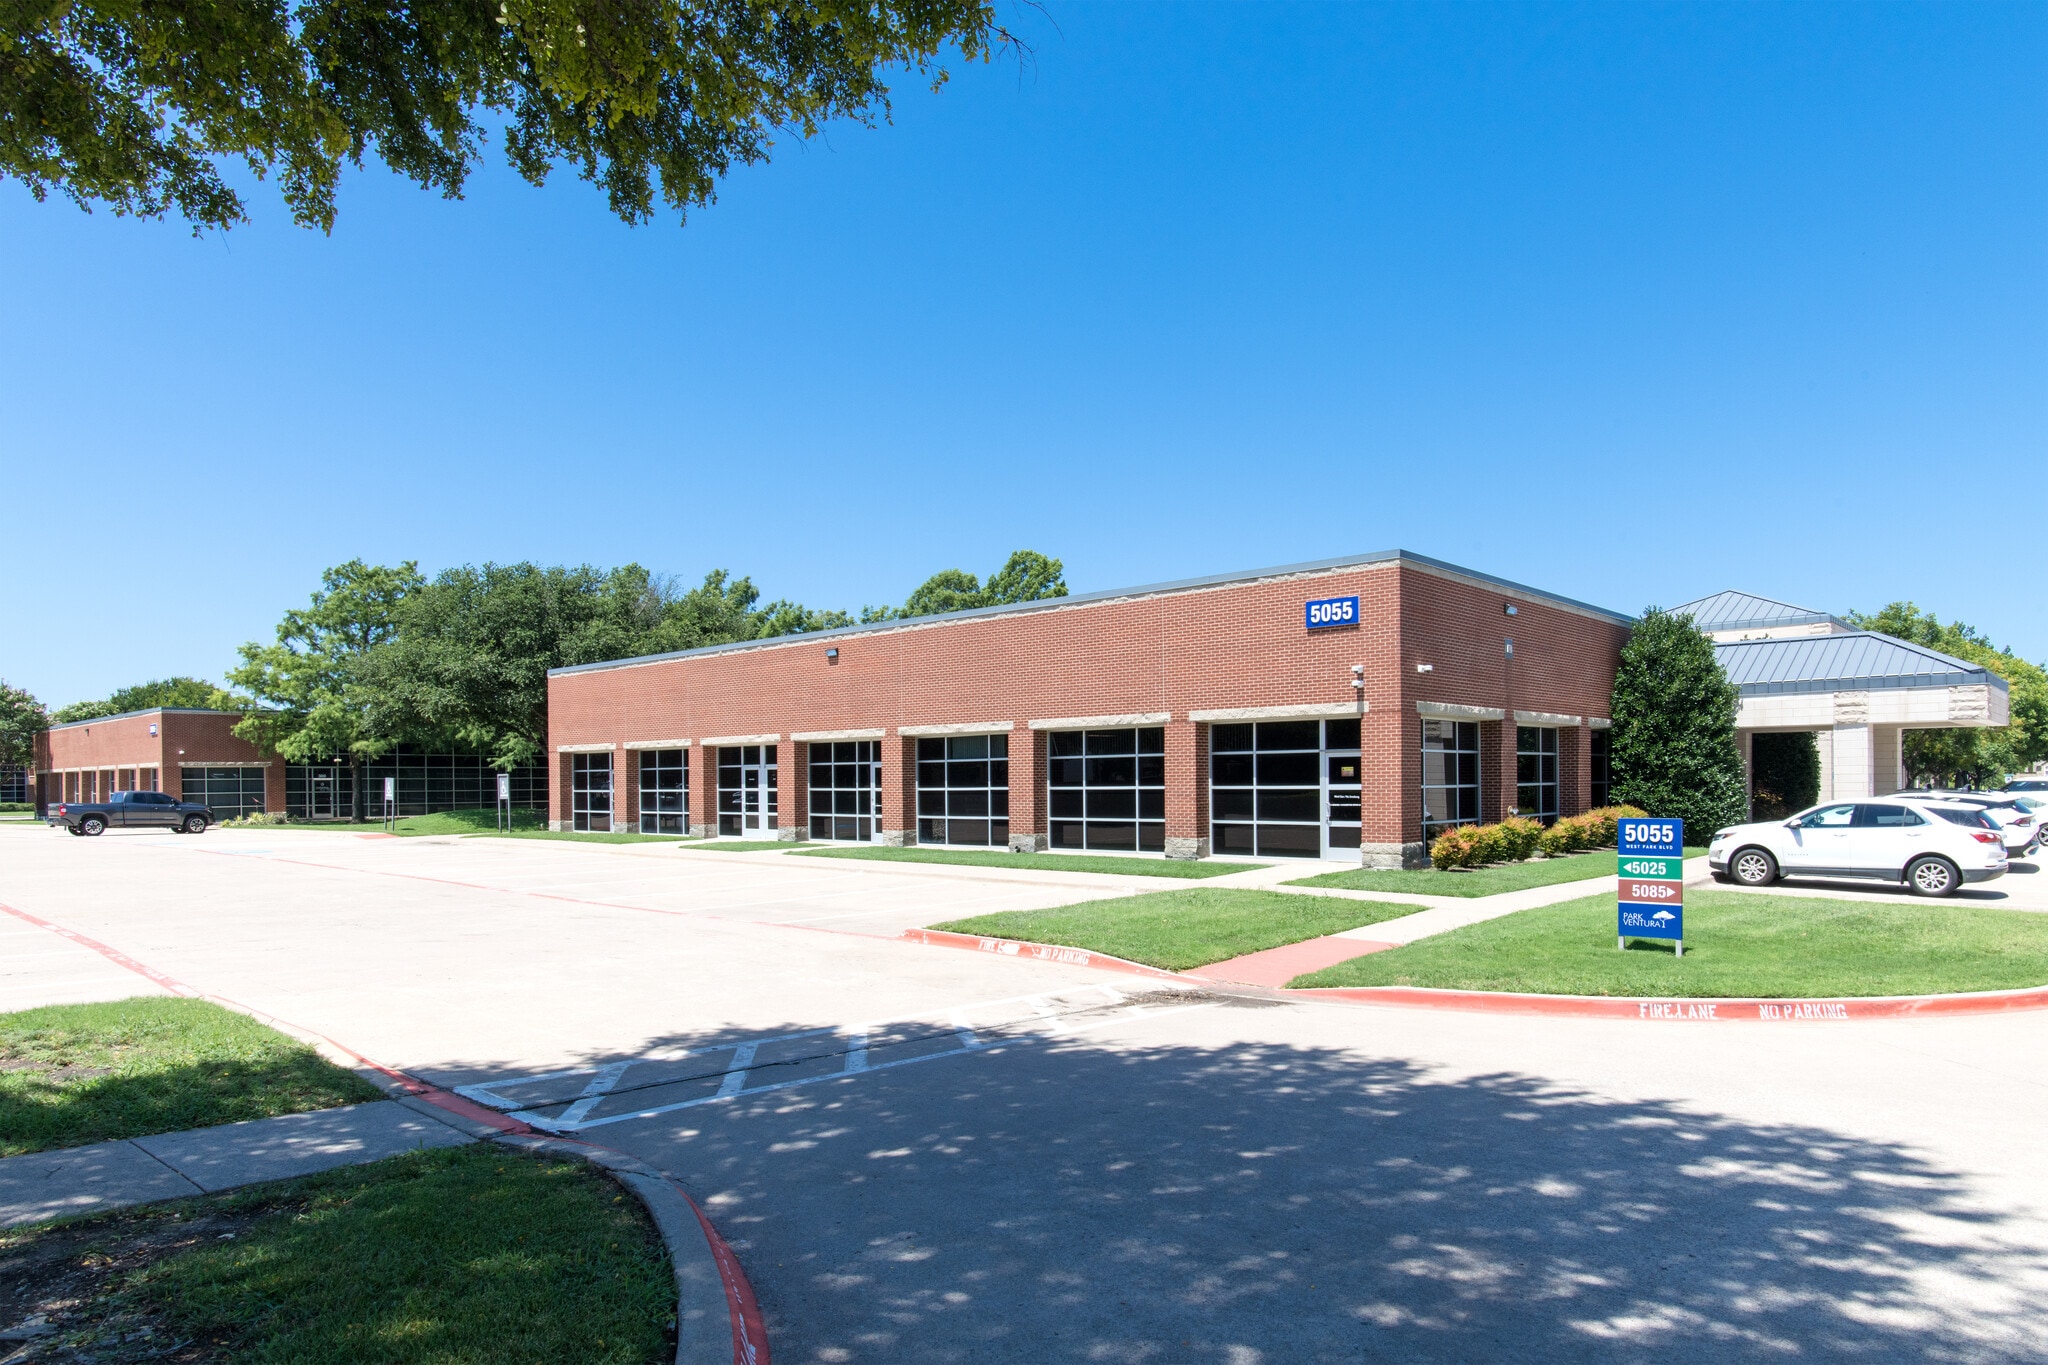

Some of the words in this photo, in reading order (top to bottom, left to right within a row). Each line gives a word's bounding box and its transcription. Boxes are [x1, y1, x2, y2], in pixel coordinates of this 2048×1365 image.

[1310, 600, 1353, 623] 5055
[1625, 824, 1673, 842] 5055
[1632, 862, 1666, 874] 5025
[1632, 885, 1666, 898] 5085
[1623, 912, 1643, 920] PARK
[1623, 919, 1661, 927] VENTURA
[1052, 949, 1090, 965] PARKING
[1639, 1002, 1672, 1019] FIRE
[1759, 1004, 1780, 1020] NO
[1783, 1003, 1849, 1020] PARKING
